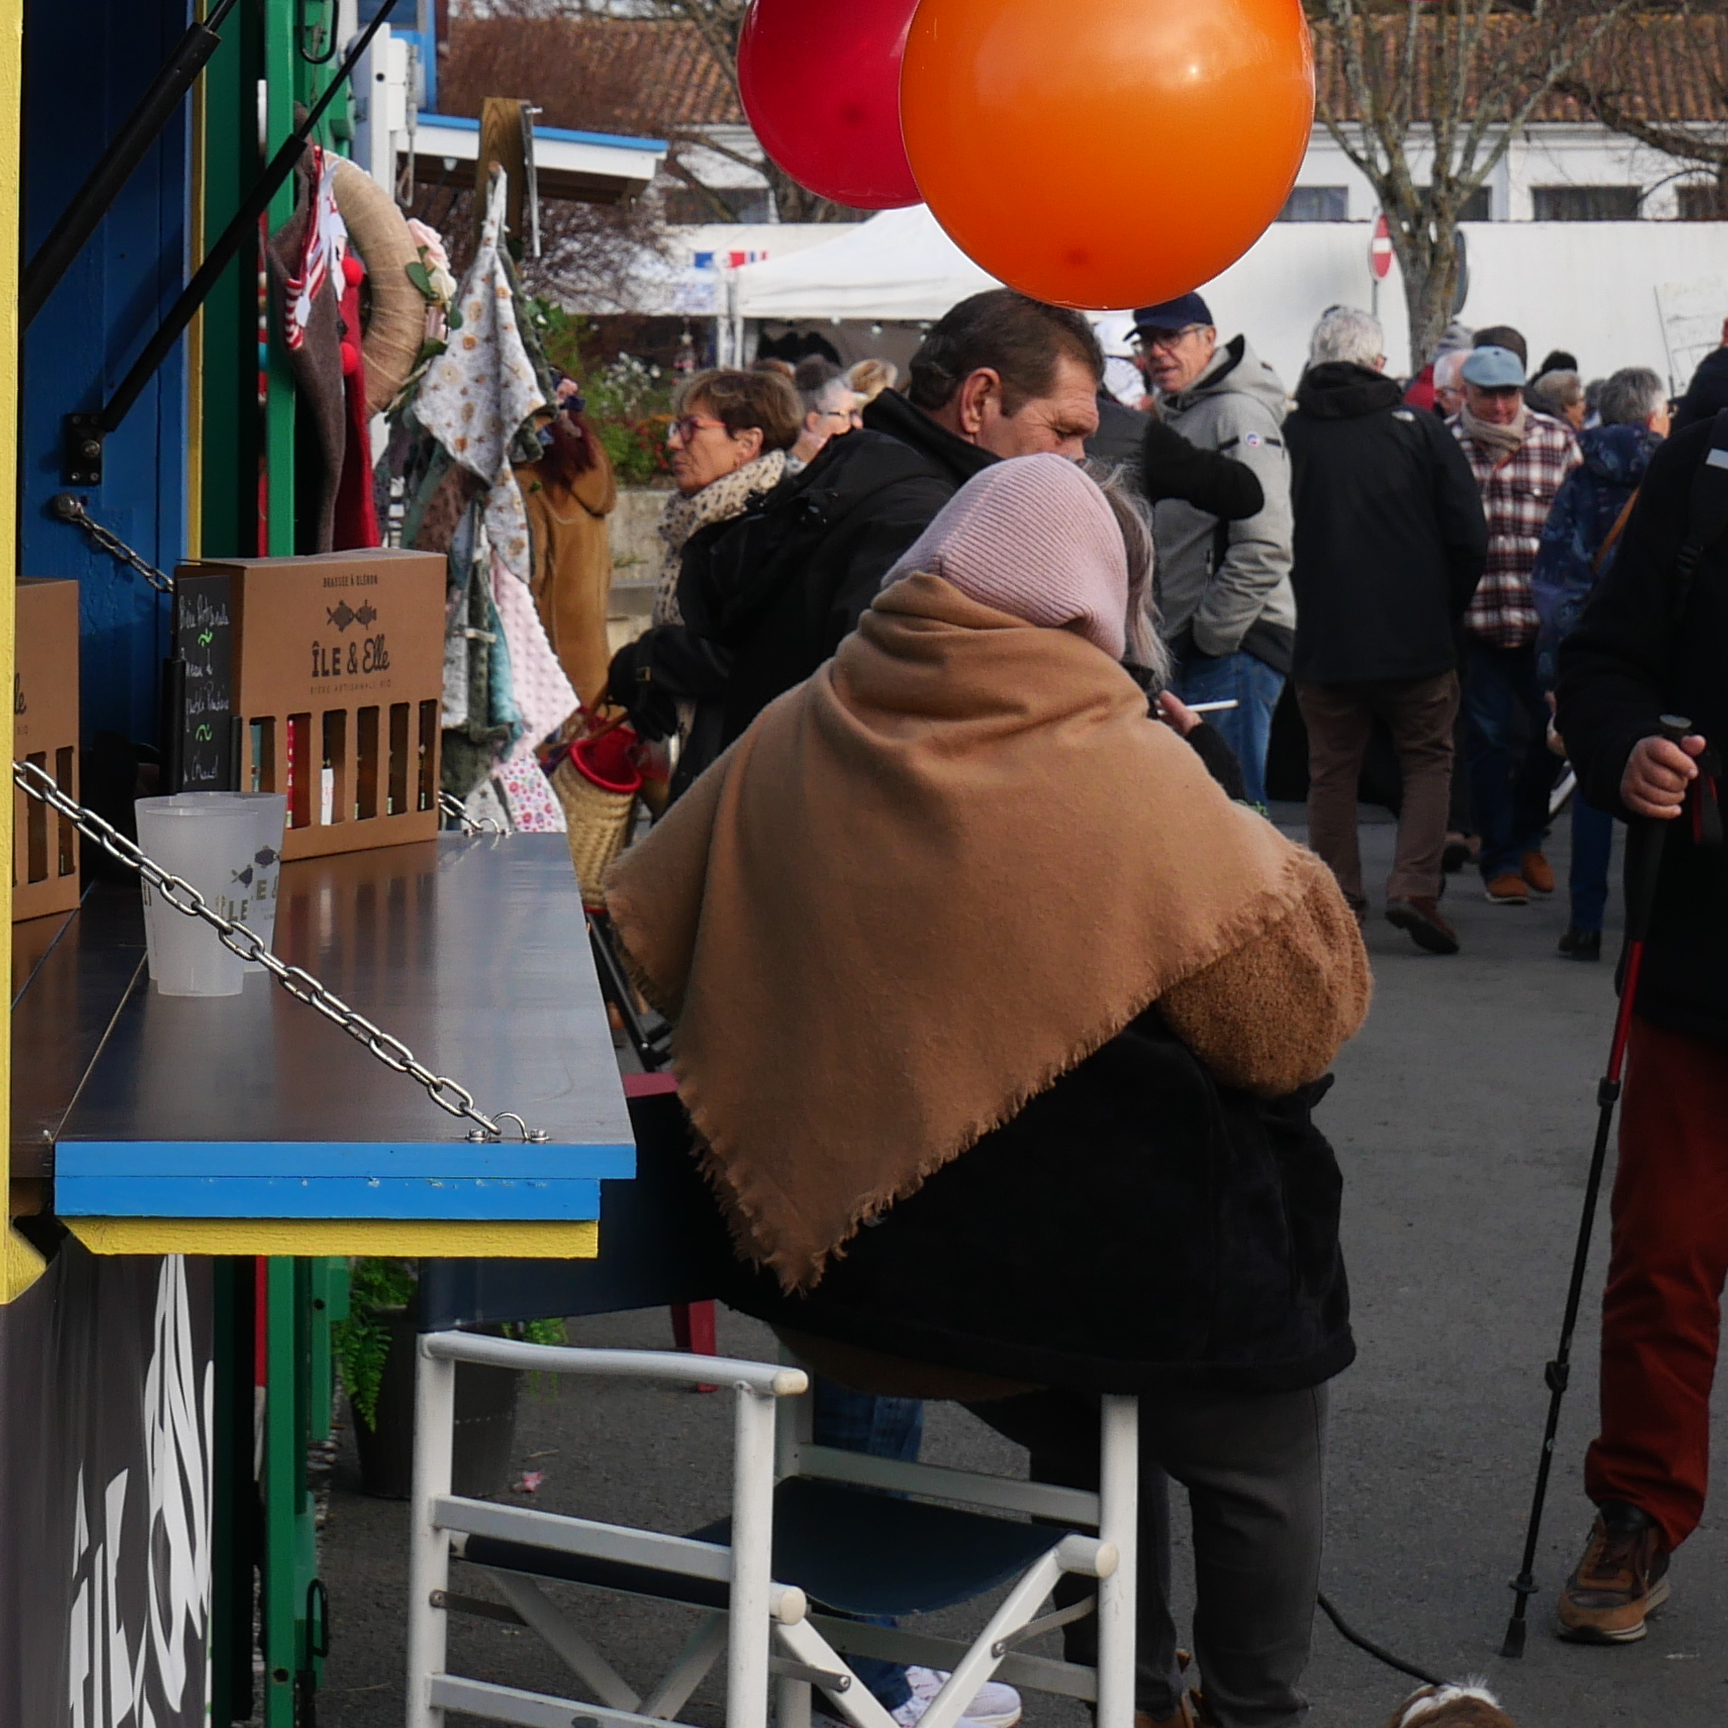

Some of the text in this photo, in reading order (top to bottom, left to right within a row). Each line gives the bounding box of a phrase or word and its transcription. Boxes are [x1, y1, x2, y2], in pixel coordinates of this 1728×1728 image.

[311, 633, 390, 678] ÎLE & Elle
